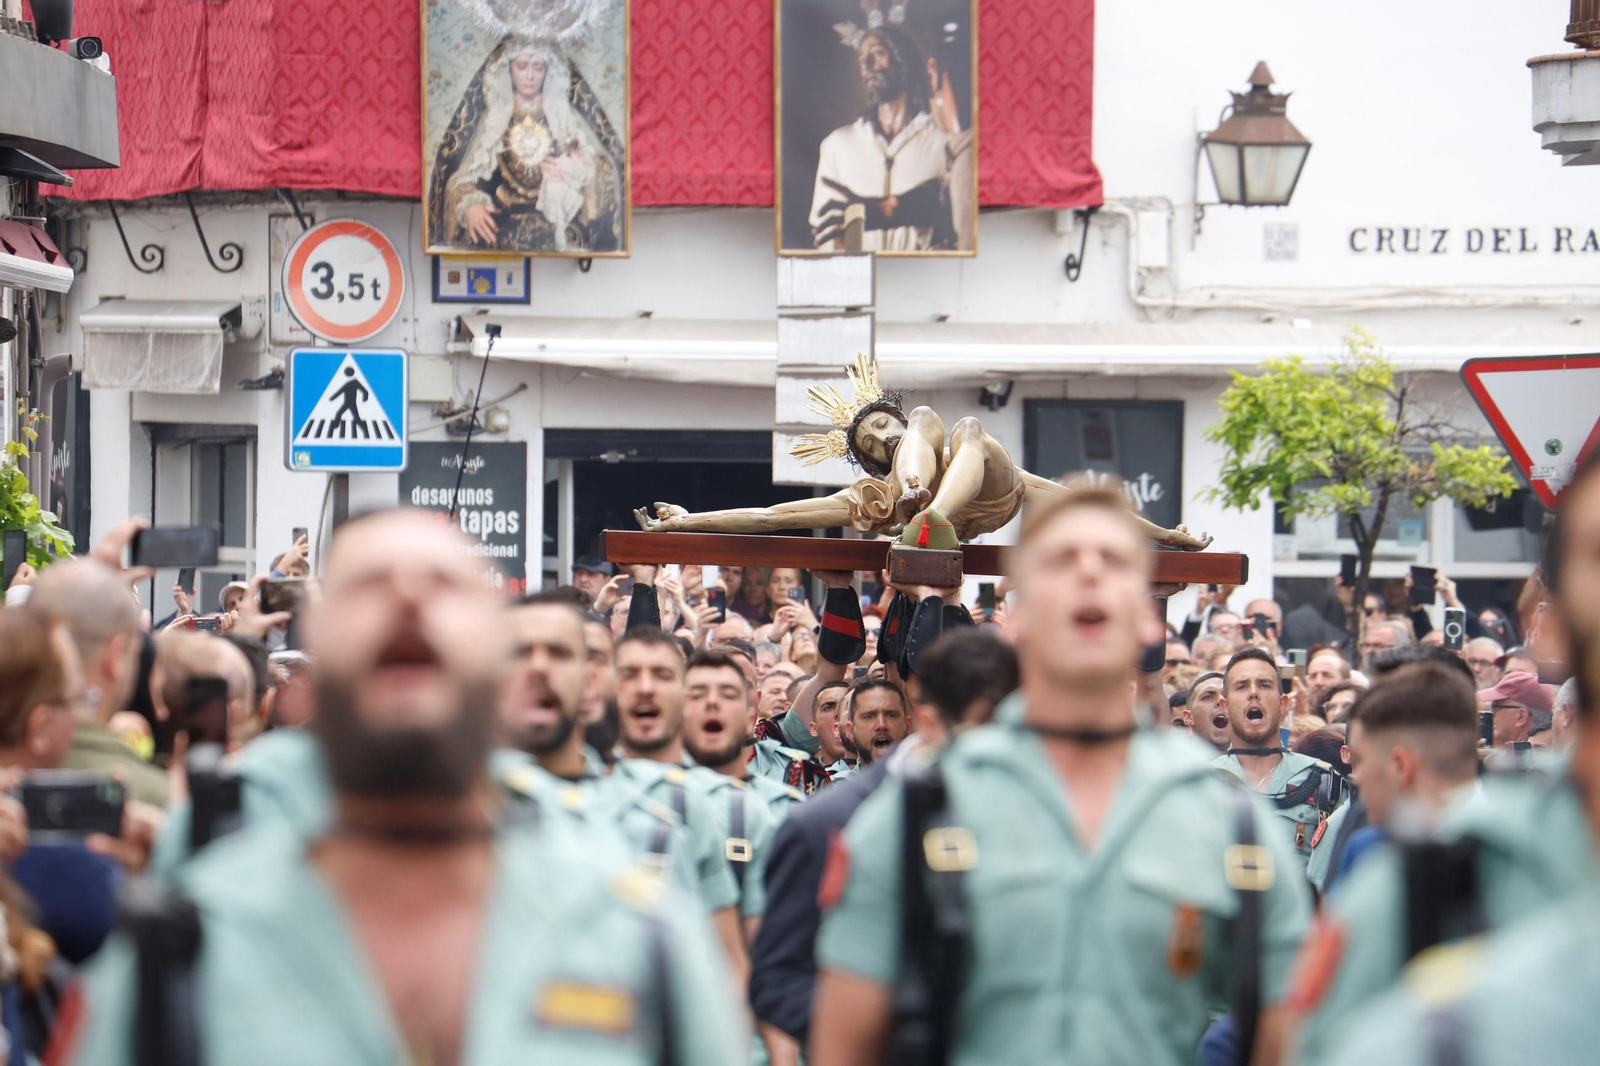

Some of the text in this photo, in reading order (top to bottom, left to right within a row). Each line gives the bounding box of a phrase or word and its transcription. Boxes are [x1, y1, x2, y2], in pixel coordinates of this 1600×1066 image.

[1348, 226, 1450, 254] CRUZ
[1466, 227, 1537, 253] DEL
[411, 485, 493, 509] desayunos
[459, 506, 518, 541] tapas
